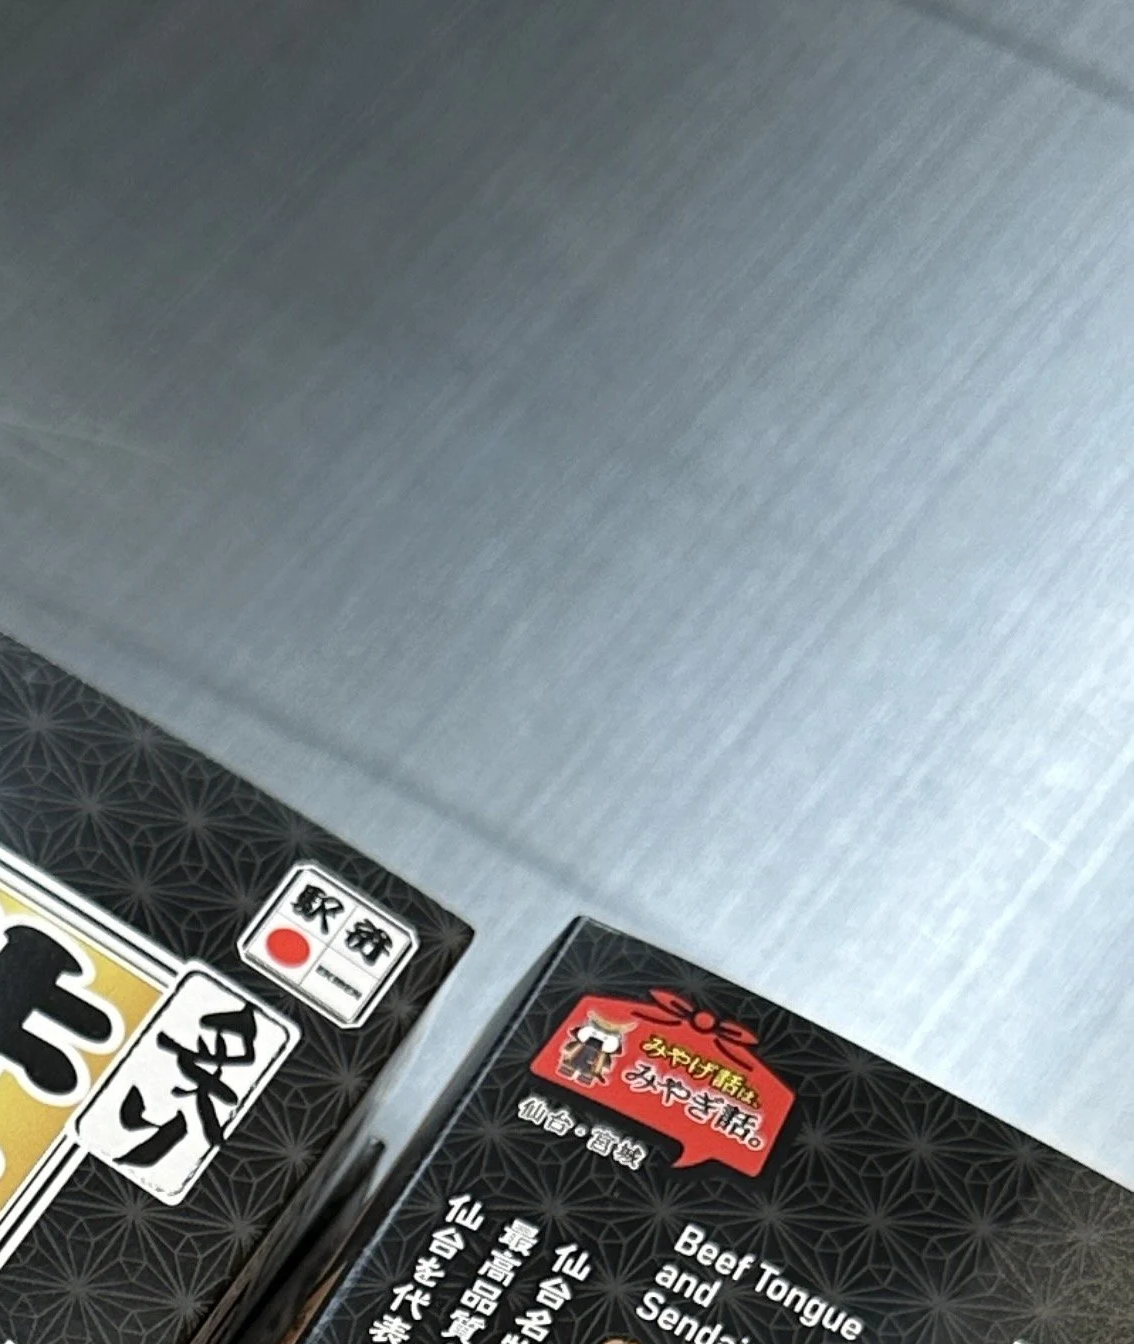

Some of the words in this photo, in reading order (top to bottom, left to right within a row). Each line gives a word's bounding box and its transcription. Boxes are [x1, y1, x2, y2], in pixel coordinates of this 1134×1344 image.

[111, 1002, 259, 1169] 炙り
[622, 1062, 766, 1152] みやぎ話。
[517, 1096, 649, 1171] 仙台・宮城
[654, 1262, 722, 1310] and
[674, 1224, 755, 1281] Beef
[753, 1263, 865, 1342] Tongue
